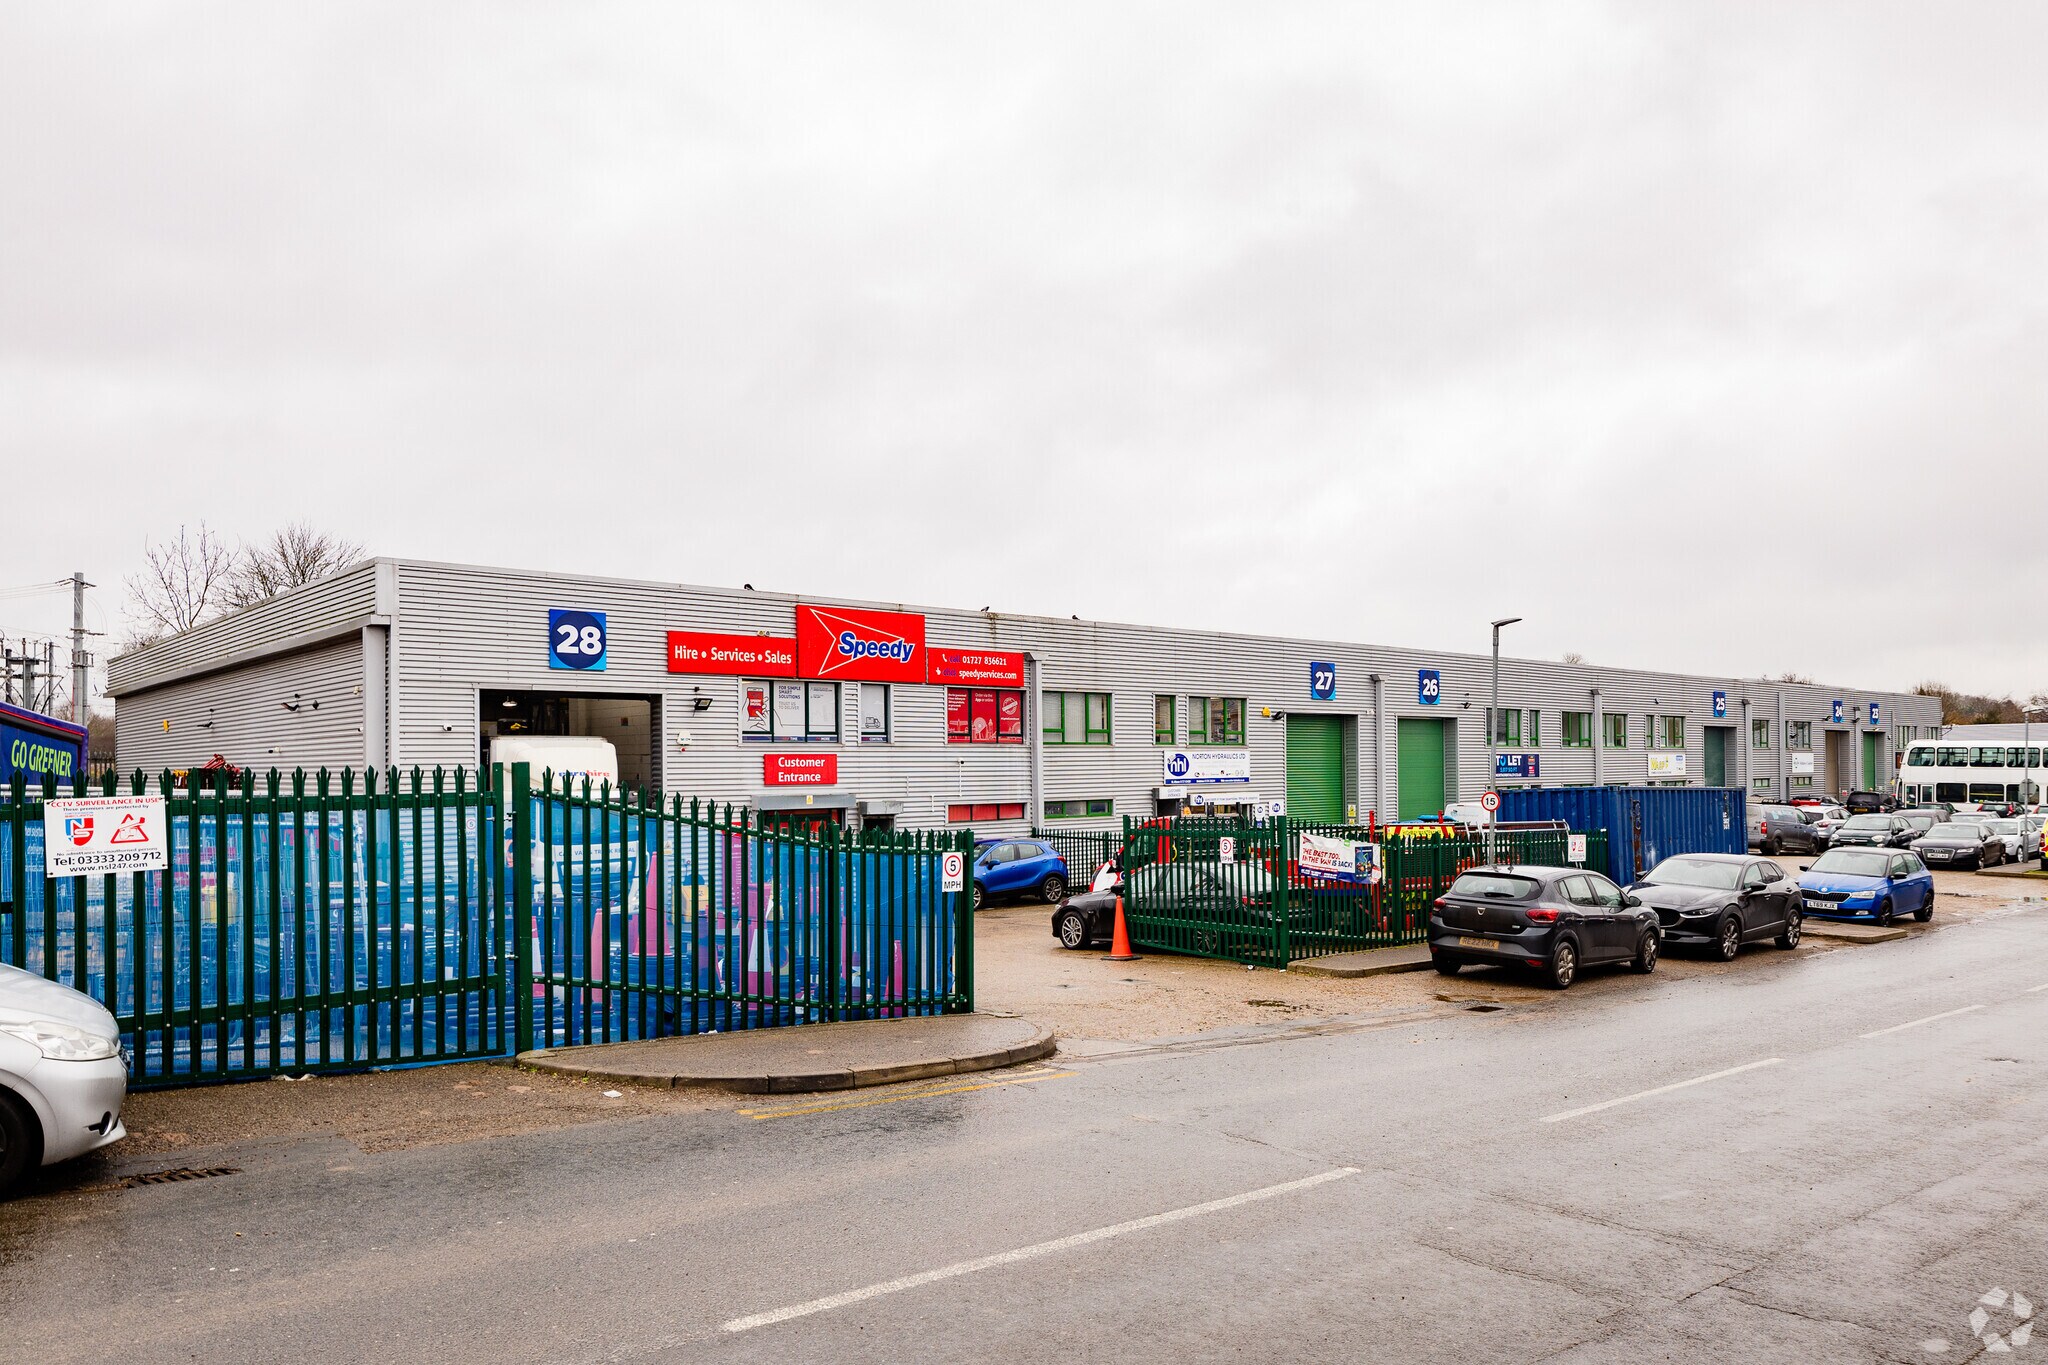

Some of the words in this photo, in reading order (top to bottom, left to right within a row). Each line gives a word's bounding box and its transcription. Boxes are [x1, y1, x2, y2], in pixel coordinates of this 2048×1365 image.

[556, 624, 603, 656] 28
[838, 631, 916, 664] Speedy
[674, 644, 698, 660] Hire
[710, 647, 756, 663] Services
[764, 649, 792, 664] Sales
[962, 655, 982, 665] 01727
[984, 656, 1007, 666] 836621
[958, 669, 1018, 680] speedyservices.com
[1315, 671, 1334, 691] 27
[1422, 678, 1439, 696] 26
[1715, 697, 1725, 711] 25
[1835, 705, 1843, 717] 24
[1871, 707, 1879, 719] 23
[11, 739, 27, 769] GO
[28, 743, 72, 778] GREENER
[778, 756, 826, 768] Customer
[1507, 755, 1522, 766] LET
[778, 771, 821, 783] Entrance
[76, 798, 134, 807] SURVEILLANCE
[1485, 797, 1496, 806] 15
[1223, 842, 1228, 850] 5
[53, 857, 76, 866] Tel:
[77, 855, 116, 865] 03333
[117, 853, 141, 863] 209
[141, 851, 162, 861] 712
[69, 861, 149, 872] www.nsl247.com
[949, 860, 957, 872] 5
[943, 880, 962, 889] MPH
